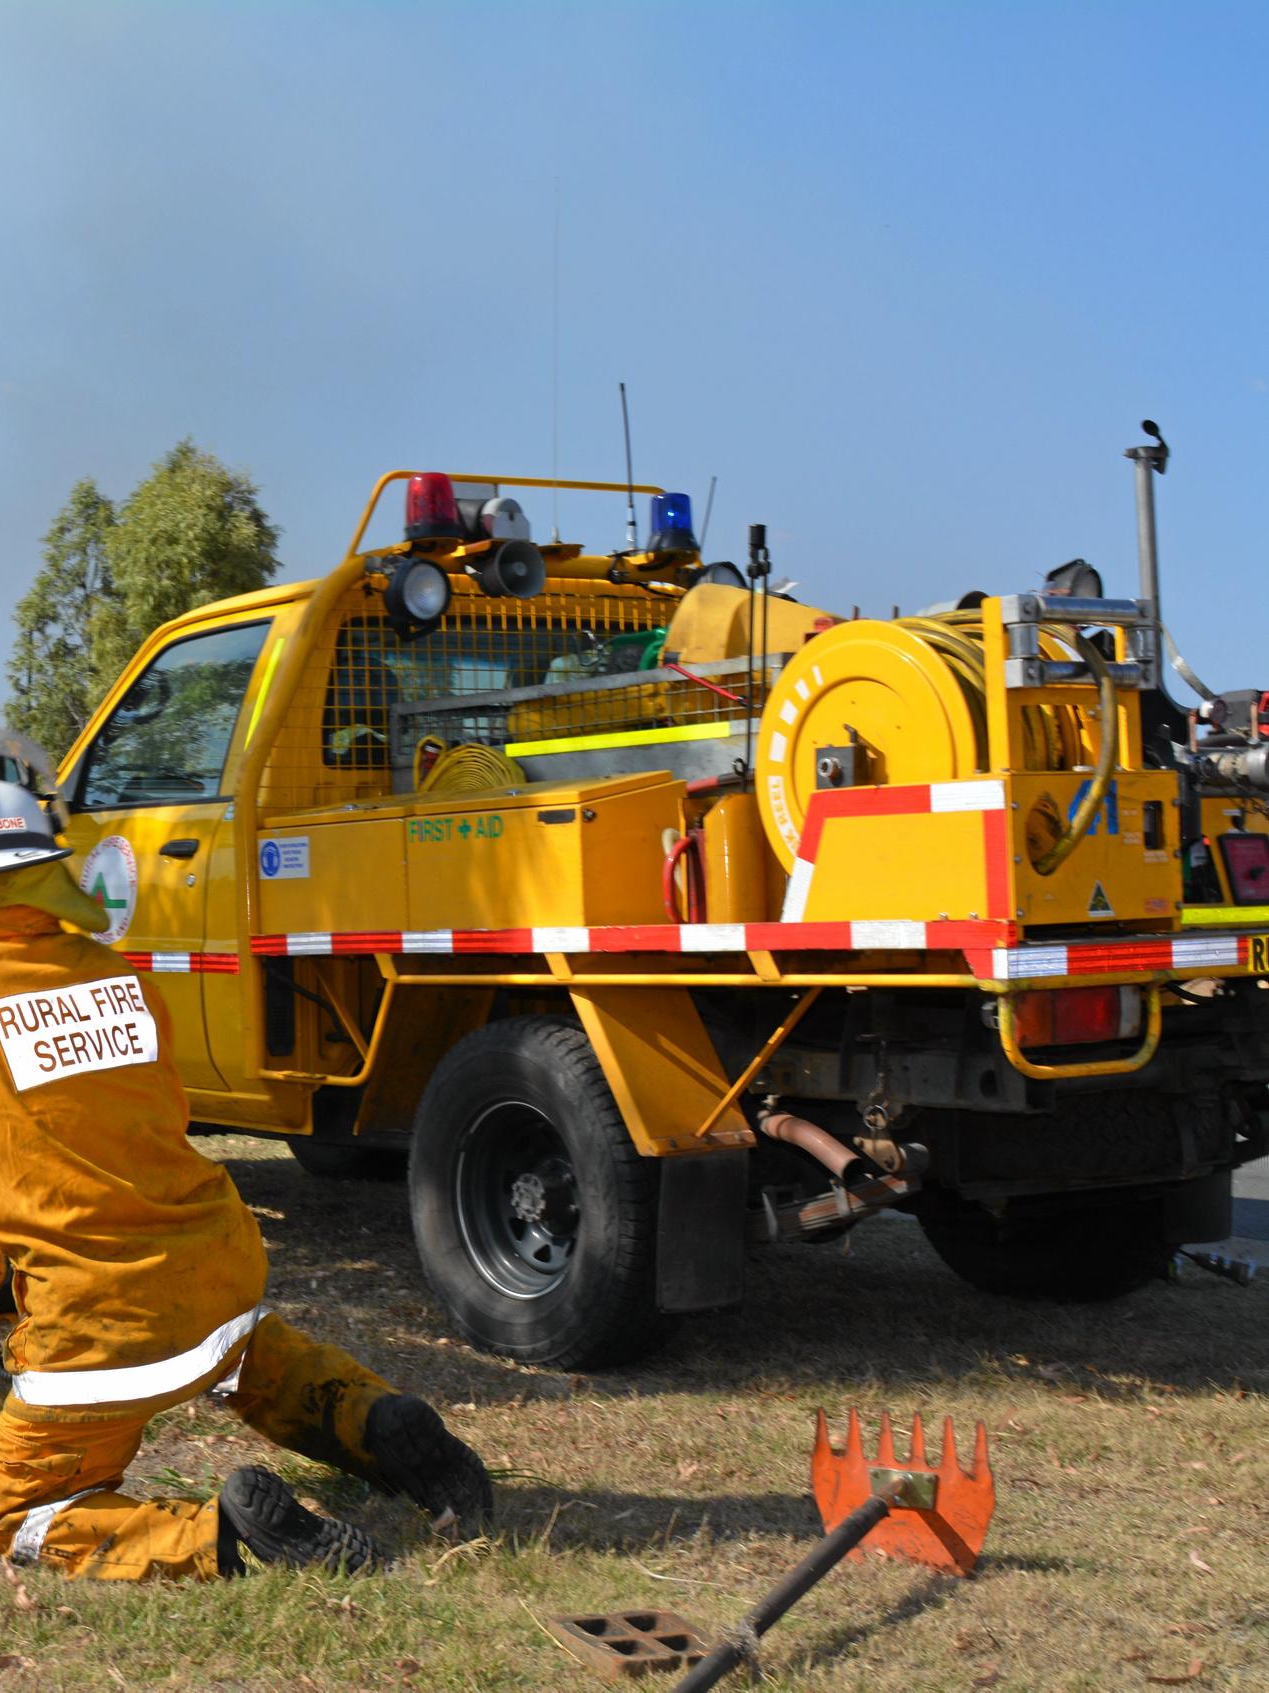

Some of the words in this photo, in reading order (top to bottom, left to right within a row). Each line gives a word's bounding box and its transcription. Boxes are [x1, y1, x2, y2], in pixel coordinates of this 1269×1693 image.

[410, 818, 453, 843] FIRST
[476, 816, 504, 838] AID
[92, 983, 145, 1017] FIRE
[33, 1022, 143, 1072] SERVICE
